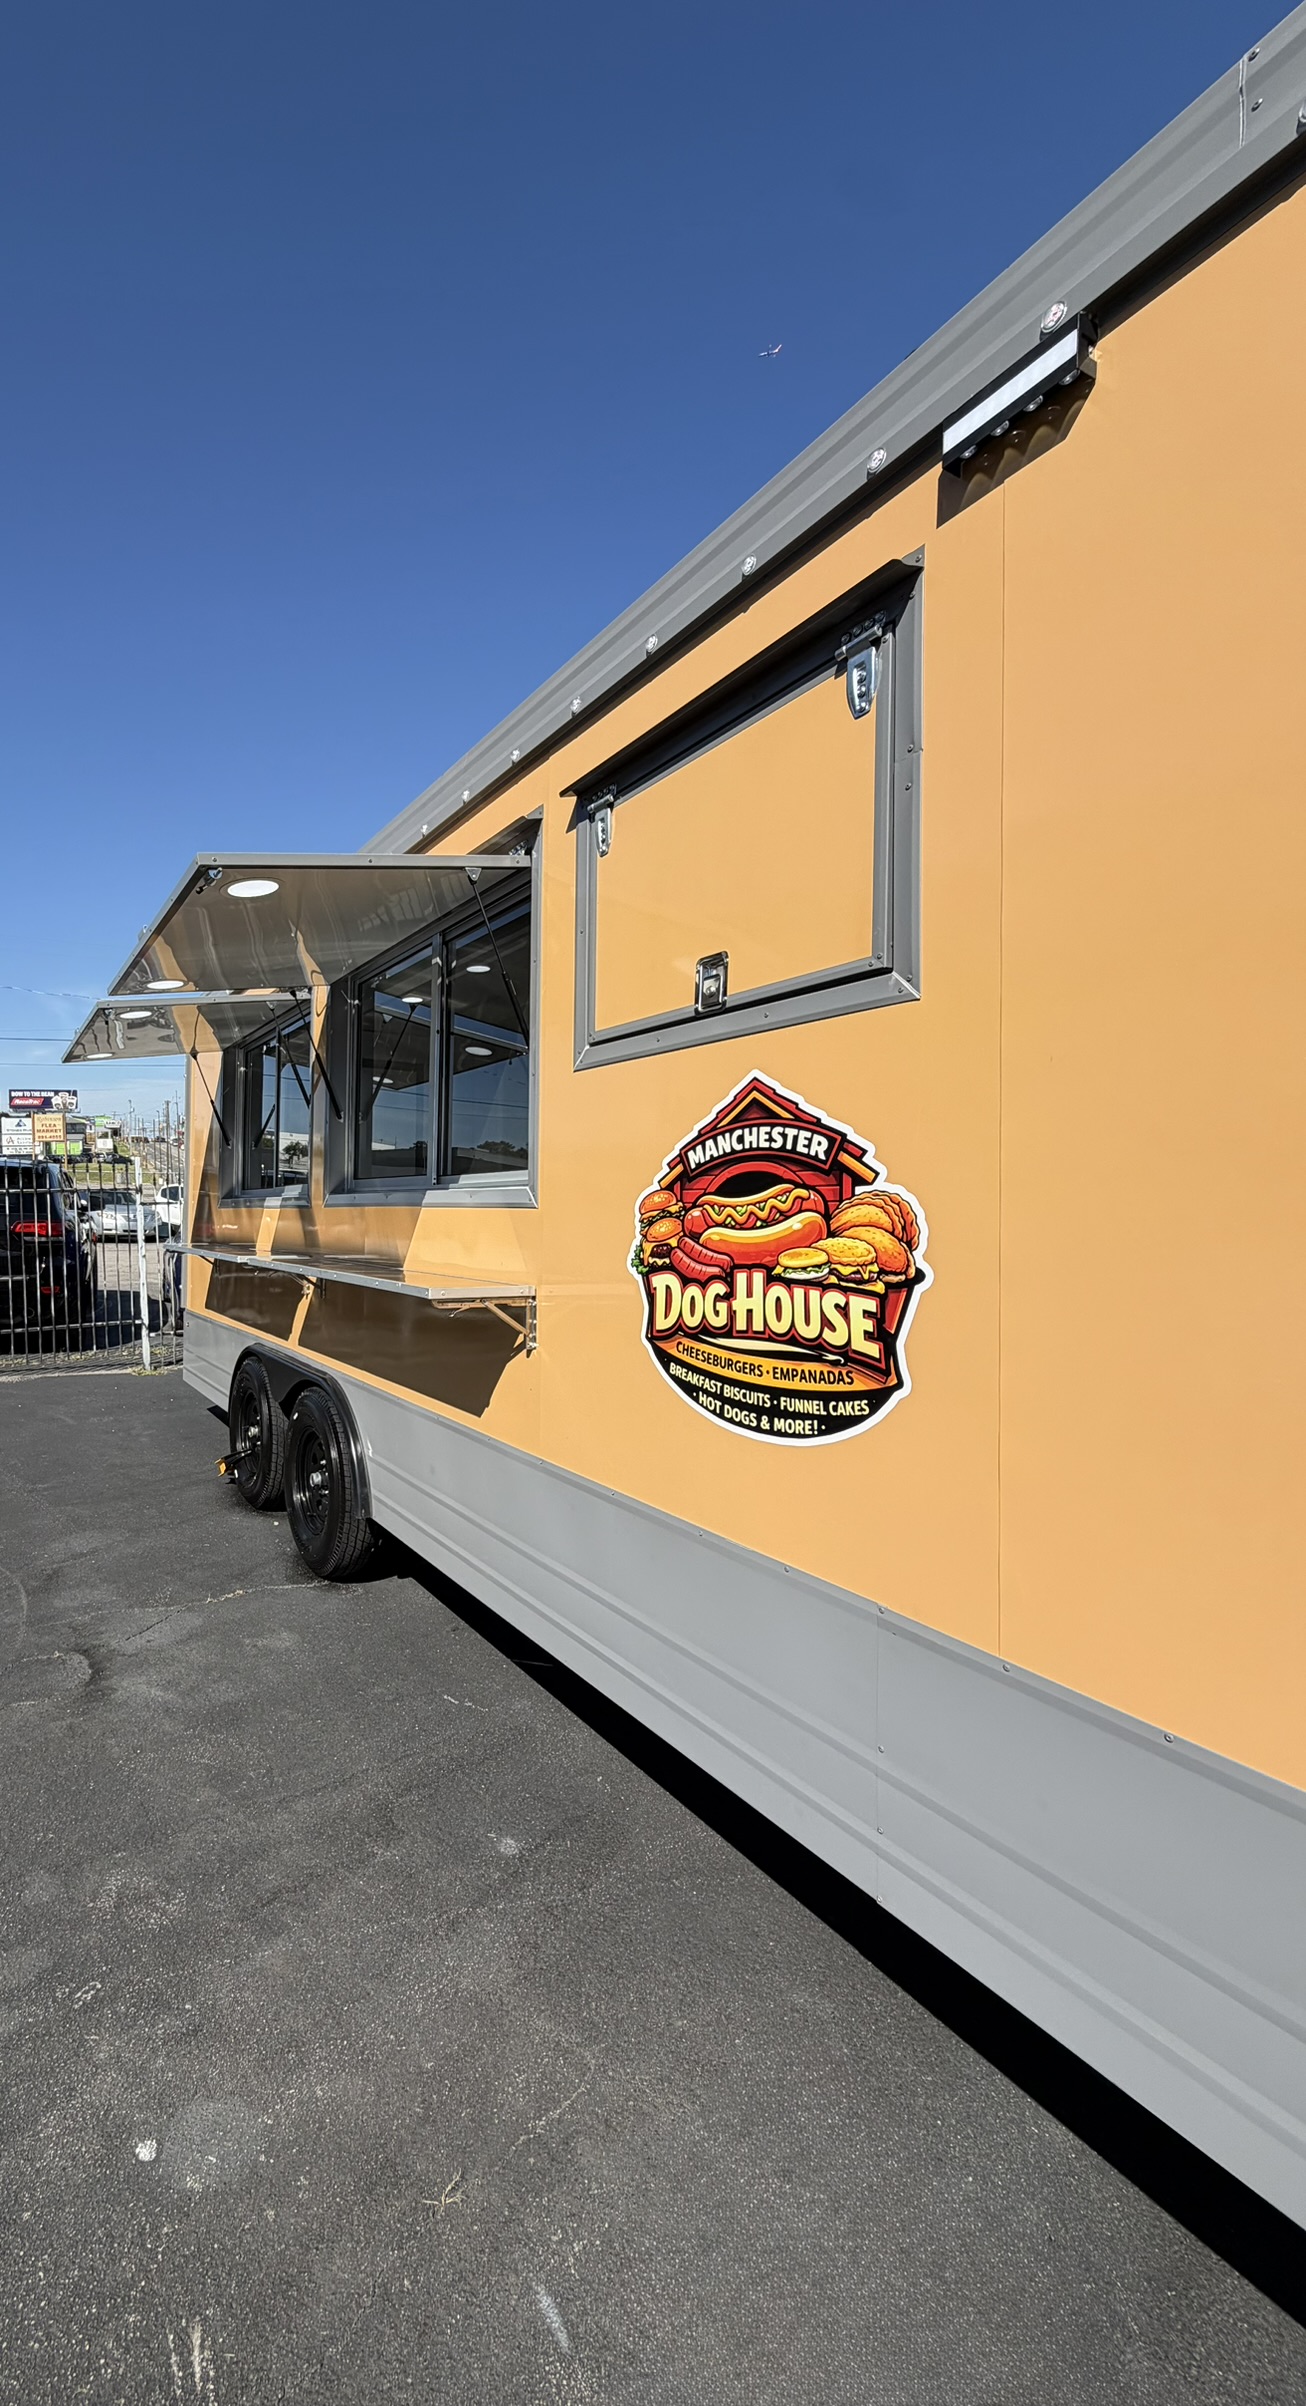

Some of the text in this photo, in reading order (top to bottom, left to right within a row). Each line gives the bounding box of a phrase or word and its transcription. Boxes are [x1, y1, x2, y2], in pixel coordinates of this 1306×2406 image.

[687, 1126, 829, 1169] MANCHESTER
[675, 1341, 855, 1386] CHEESEBURGERS EMPANADAS
[669, 1362, 870, 1416] BREAKFAST BISCUITS FUNNEL CAKES
[698, 1391, 818, 1435] HOT DOGS & MORE!
